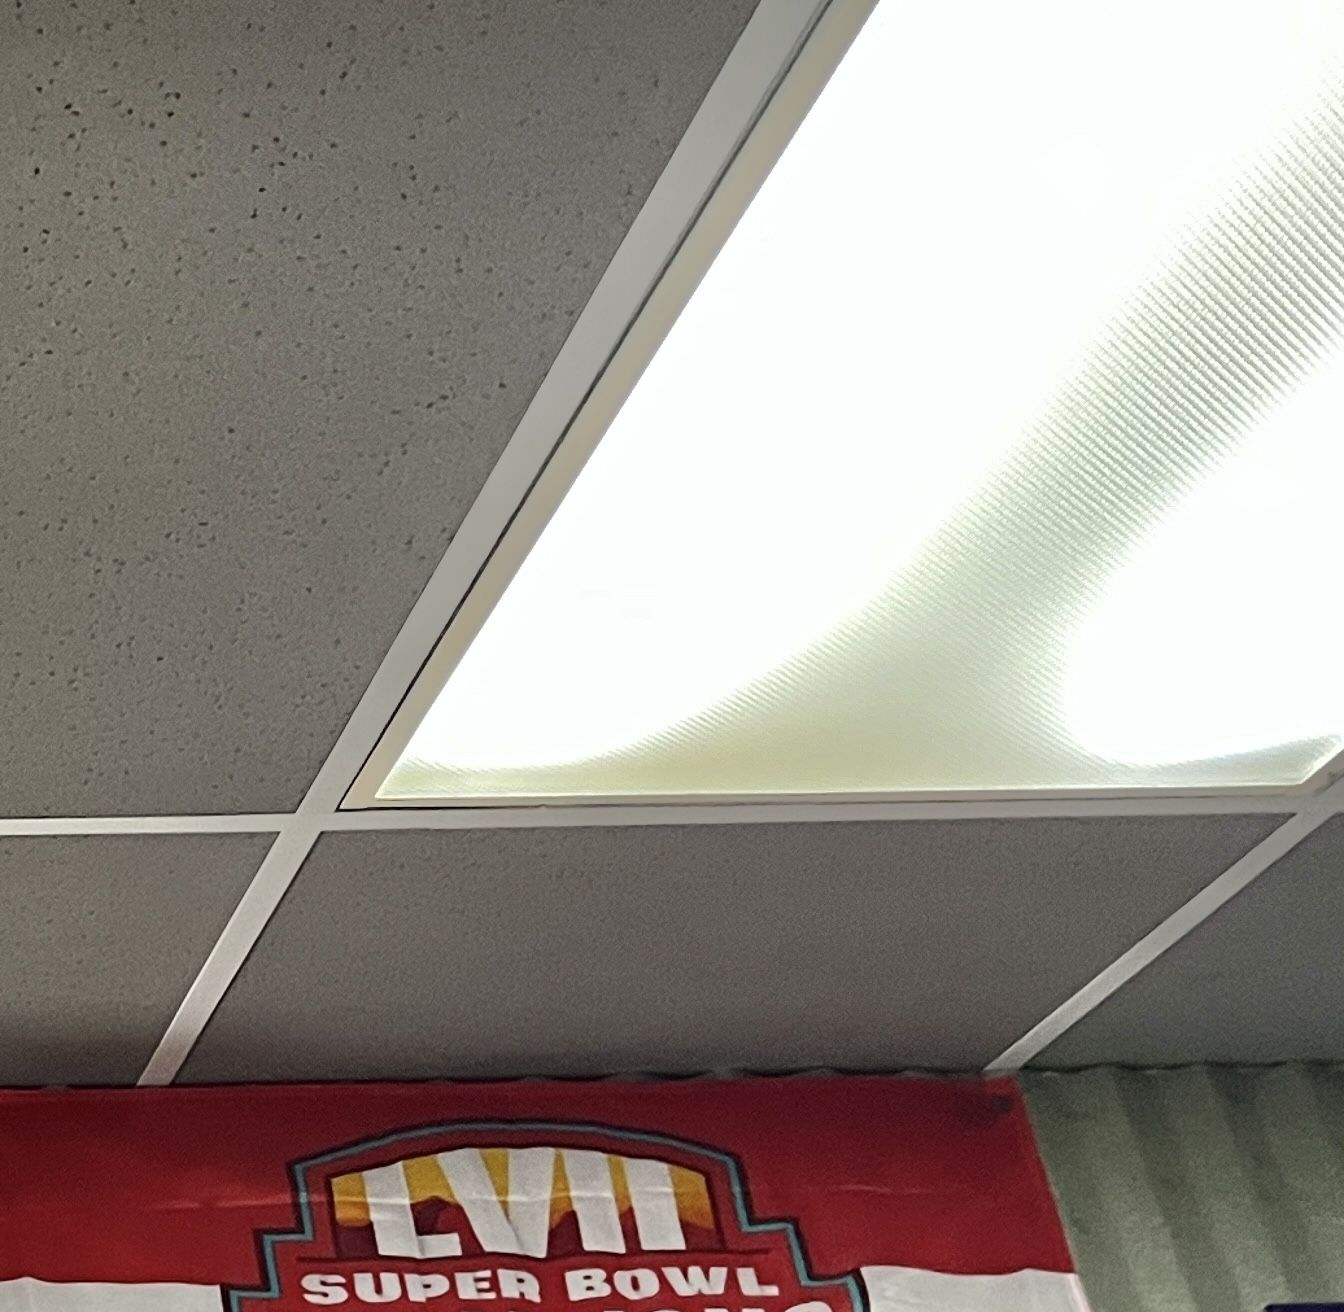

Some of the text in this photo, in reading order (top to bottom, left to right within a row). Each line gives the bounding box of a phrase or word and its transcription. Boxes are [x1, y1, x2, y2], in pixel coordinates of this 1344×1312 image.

[362, 1147, 687, 1258] LVII
[301, 1265, 780, 1306] SUPER BOWL
